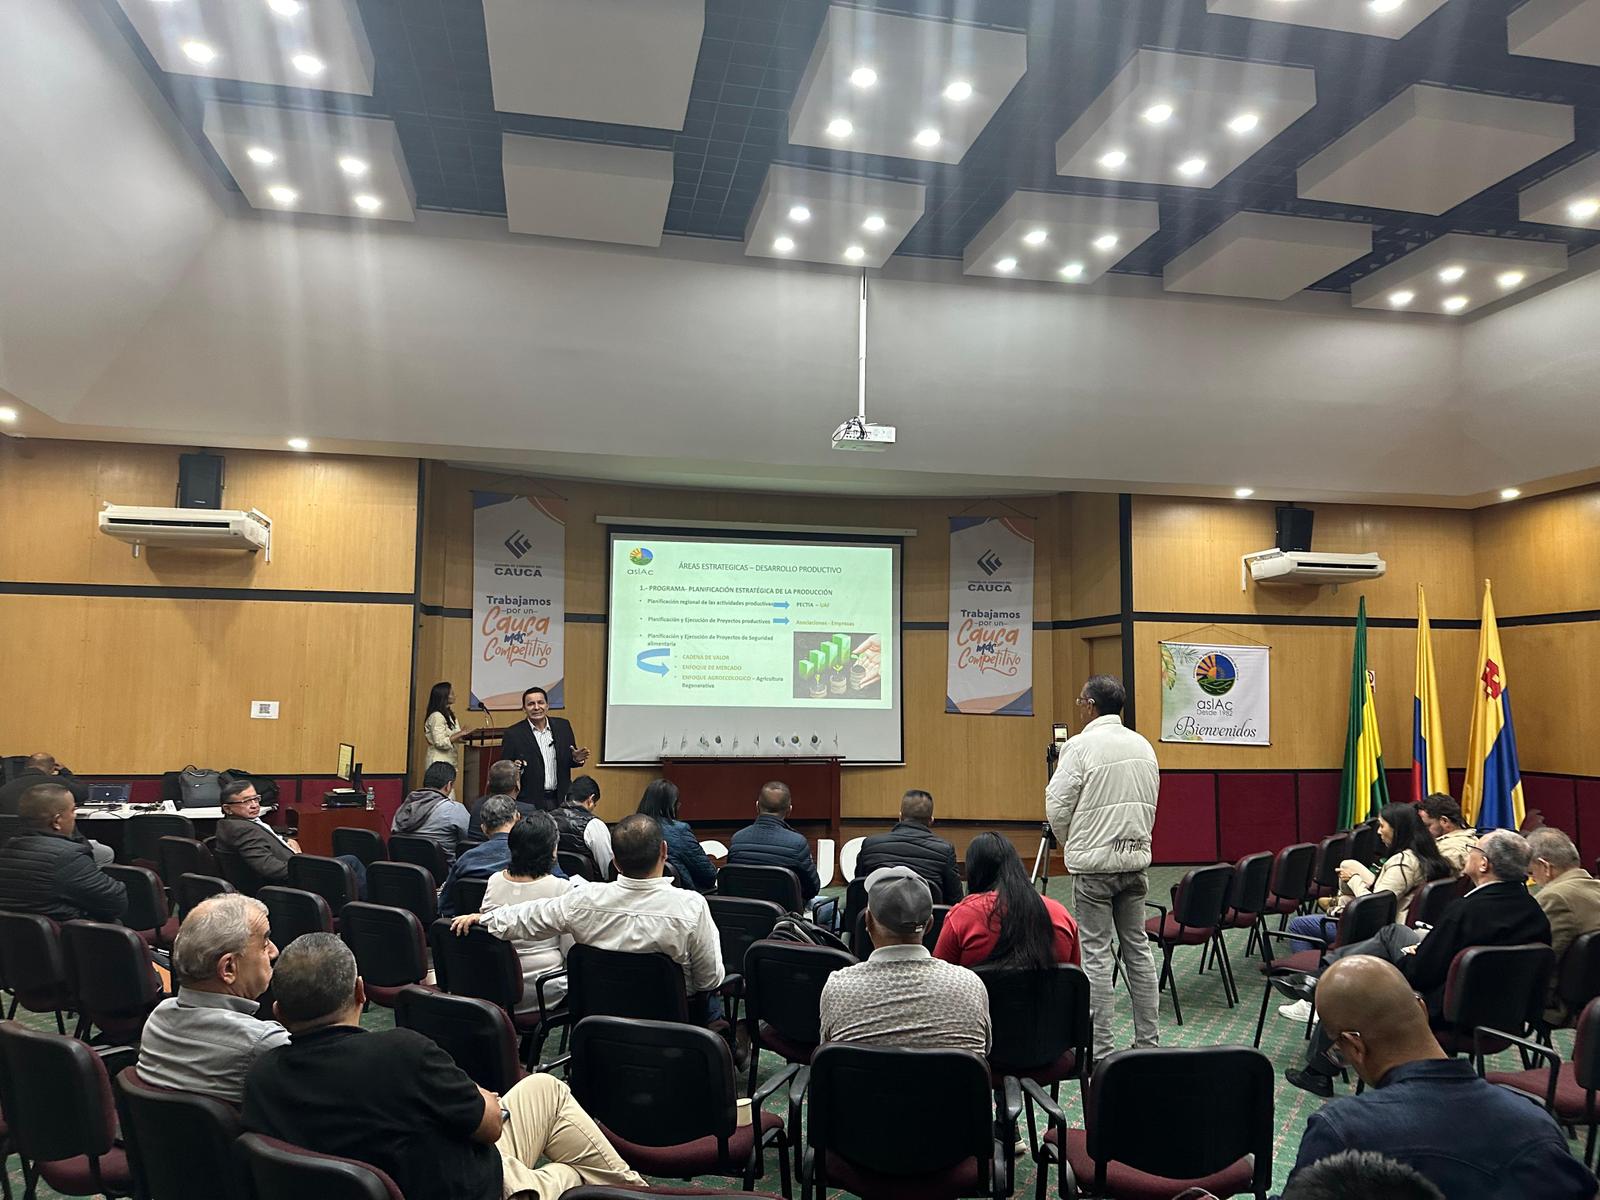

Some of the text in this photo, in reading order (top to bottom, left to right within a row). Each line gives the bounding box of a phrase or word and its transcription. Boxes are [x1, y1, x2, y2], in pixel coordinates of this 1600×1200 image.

[494, 567, 543, 577] CAUCA
[678, 562, 700, 570] ÁREAS
[701, 563, 748, 571] ESTRATEGICAS
[798, 566, 842, 574] PRODUCTIVO
[688, 585, 734, 593] PLANIFICACIÓN
[967, 583, 1012, 592] CAUCA
[486, 595, 552, 607] Trabajamos
[960, 608, 1021, 620] Trabajamos
[483, 637, 552, 668] Competitivo
[958, 646, 1021, 677] Competitivo
[1174, 716, 1257, 738] Bienvenidos
